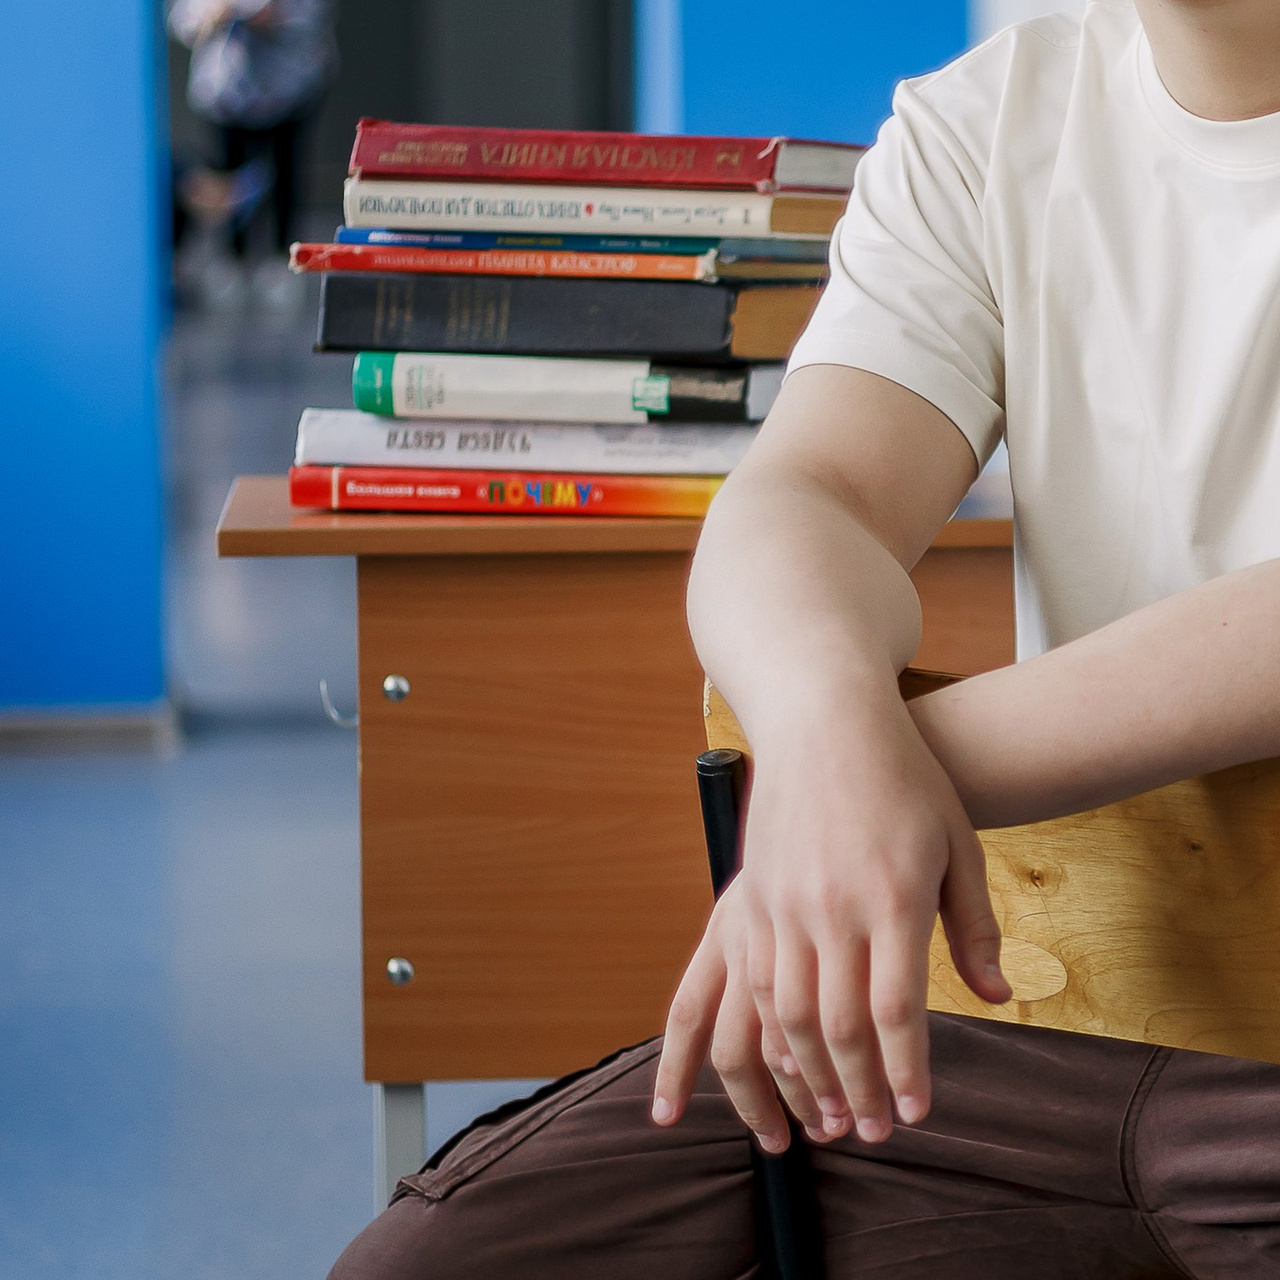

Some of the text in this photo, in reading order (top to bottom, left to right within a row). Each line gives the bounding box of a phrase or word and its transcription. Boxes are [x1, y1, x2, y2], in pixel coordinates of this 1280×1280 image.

[480, 141, 567, 166] КНИГА
[571, 143, 697, 169] КРАСНАЯ
[386, 427, 532, 453] ЧУДЕСА СВЕТА
